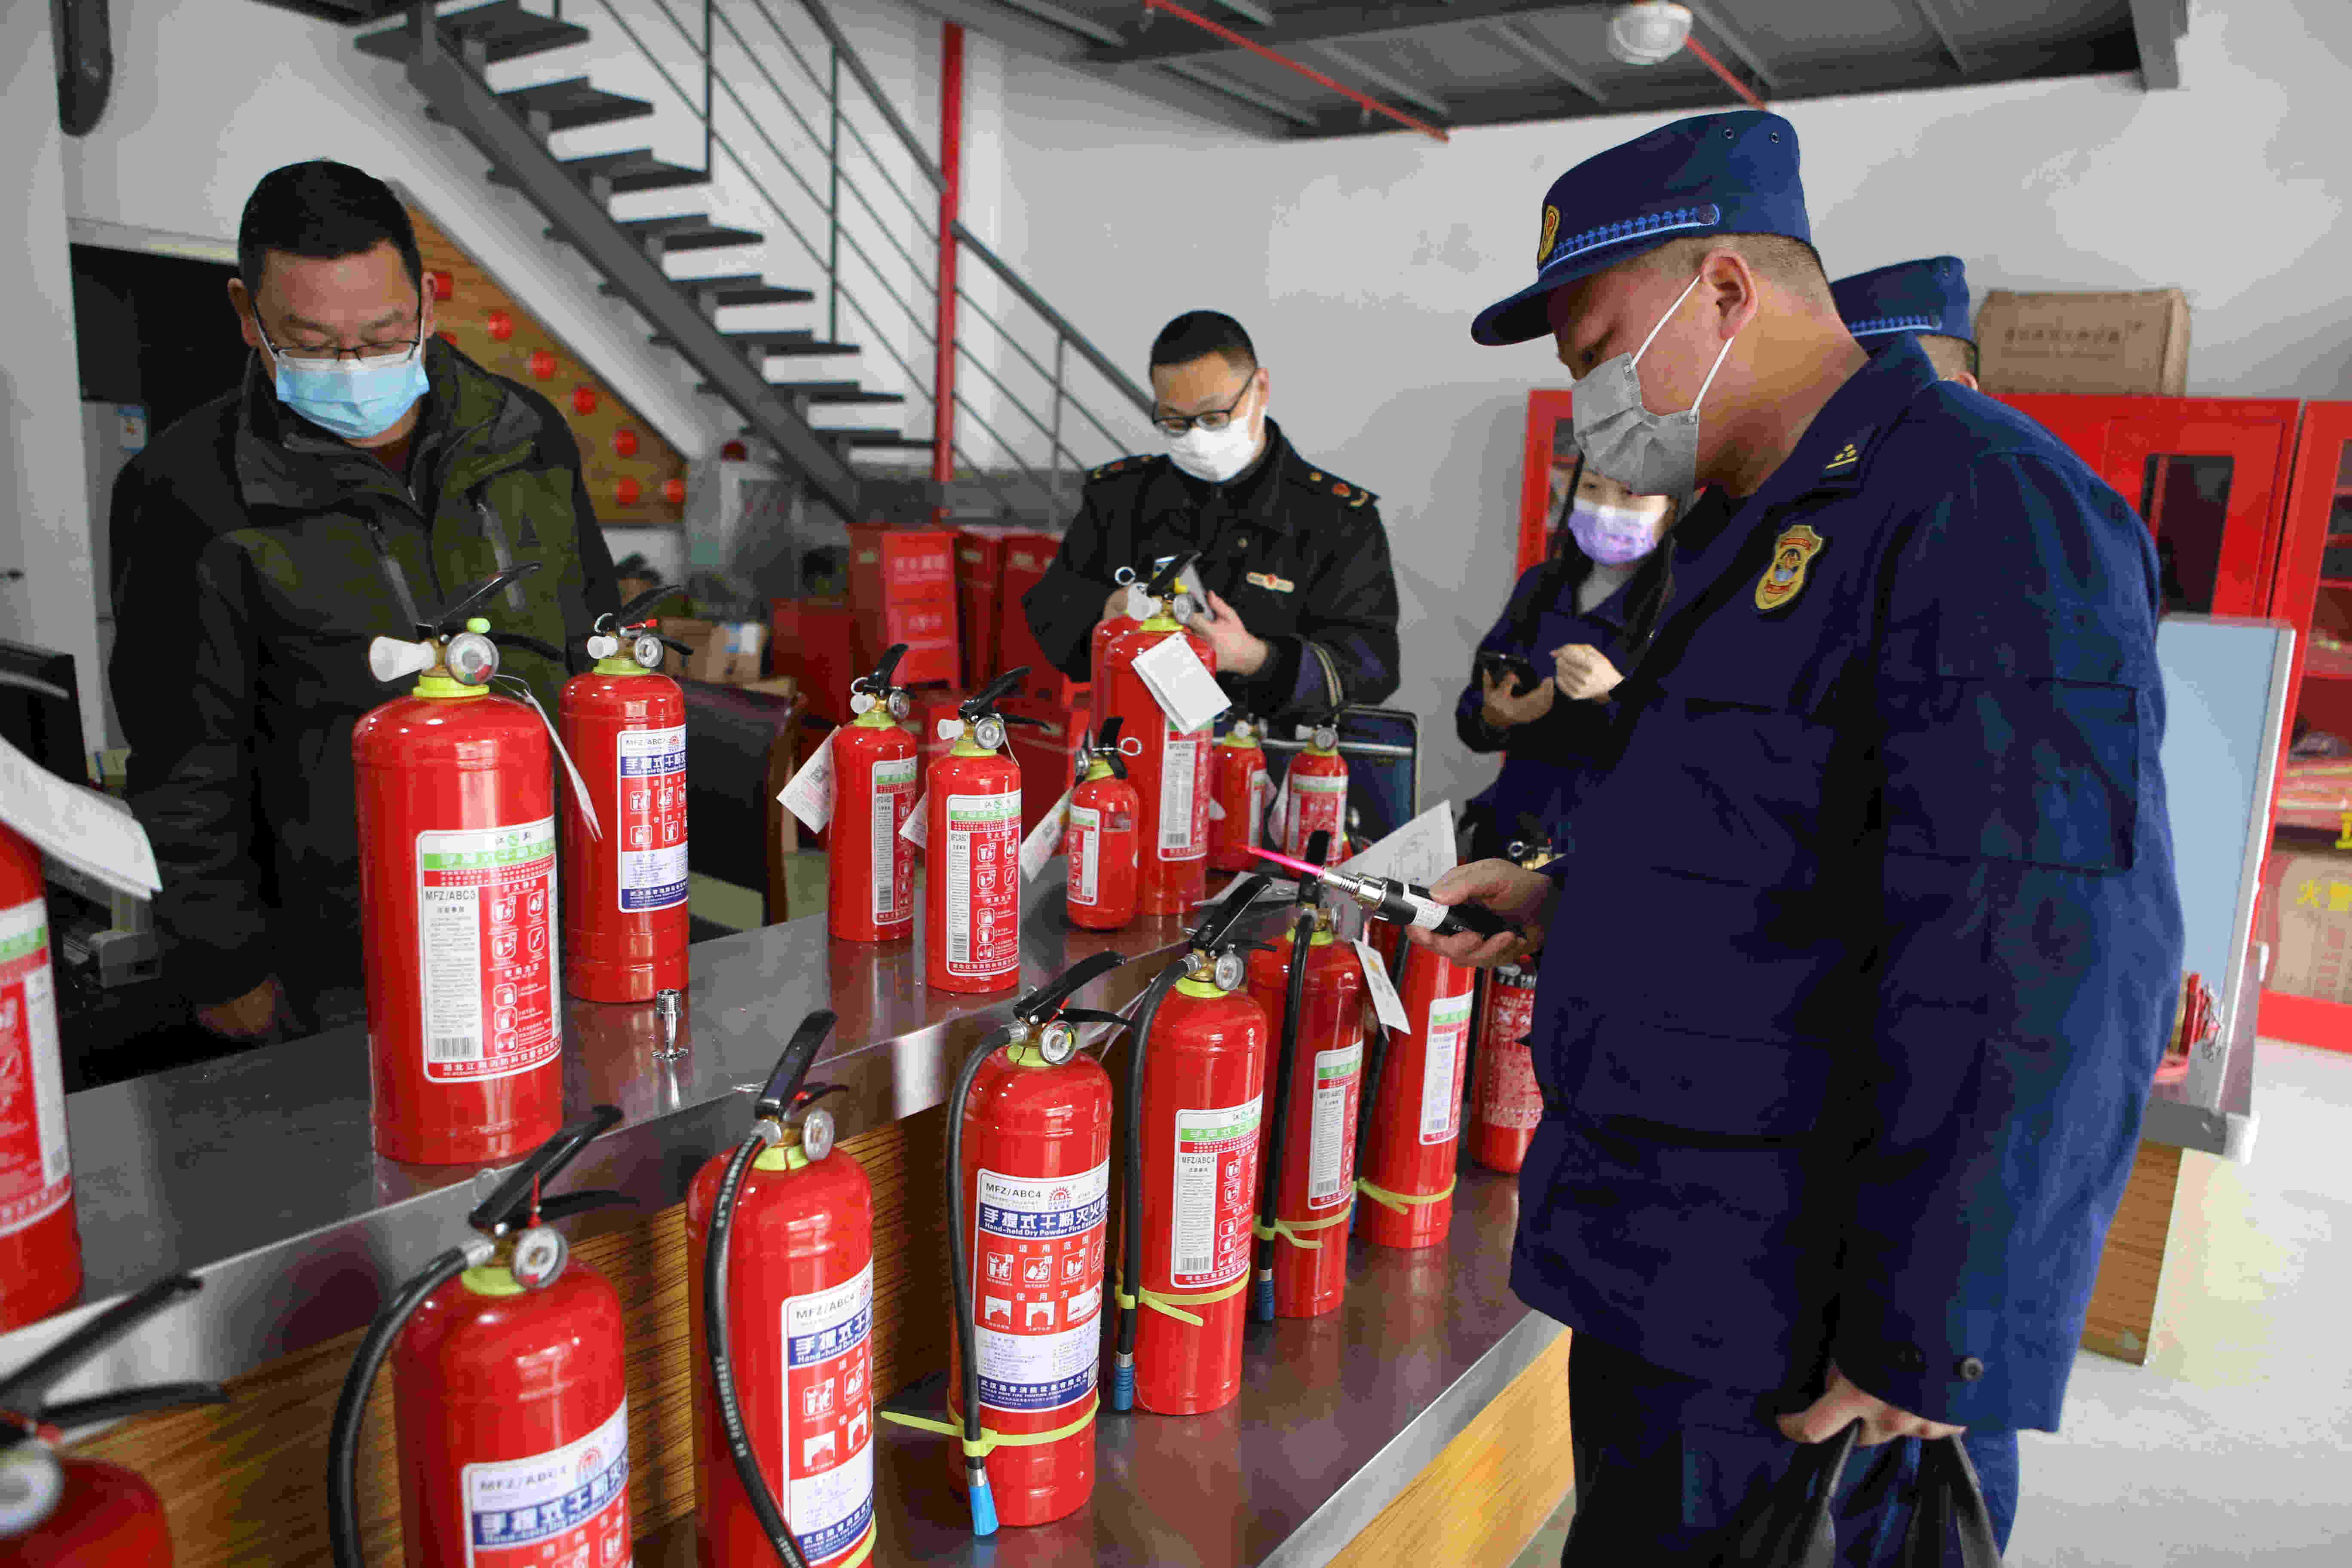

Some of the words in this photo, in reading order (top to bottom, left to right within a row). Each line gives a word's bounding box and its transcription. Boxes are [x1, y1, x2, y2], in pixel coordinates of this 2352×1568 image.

[986, 1182, 1042, 1199] MFZ/ABC4
[1024, 1228, 1038, 1237] Dry
[1040, 1226, 1067, 1236] Powder
